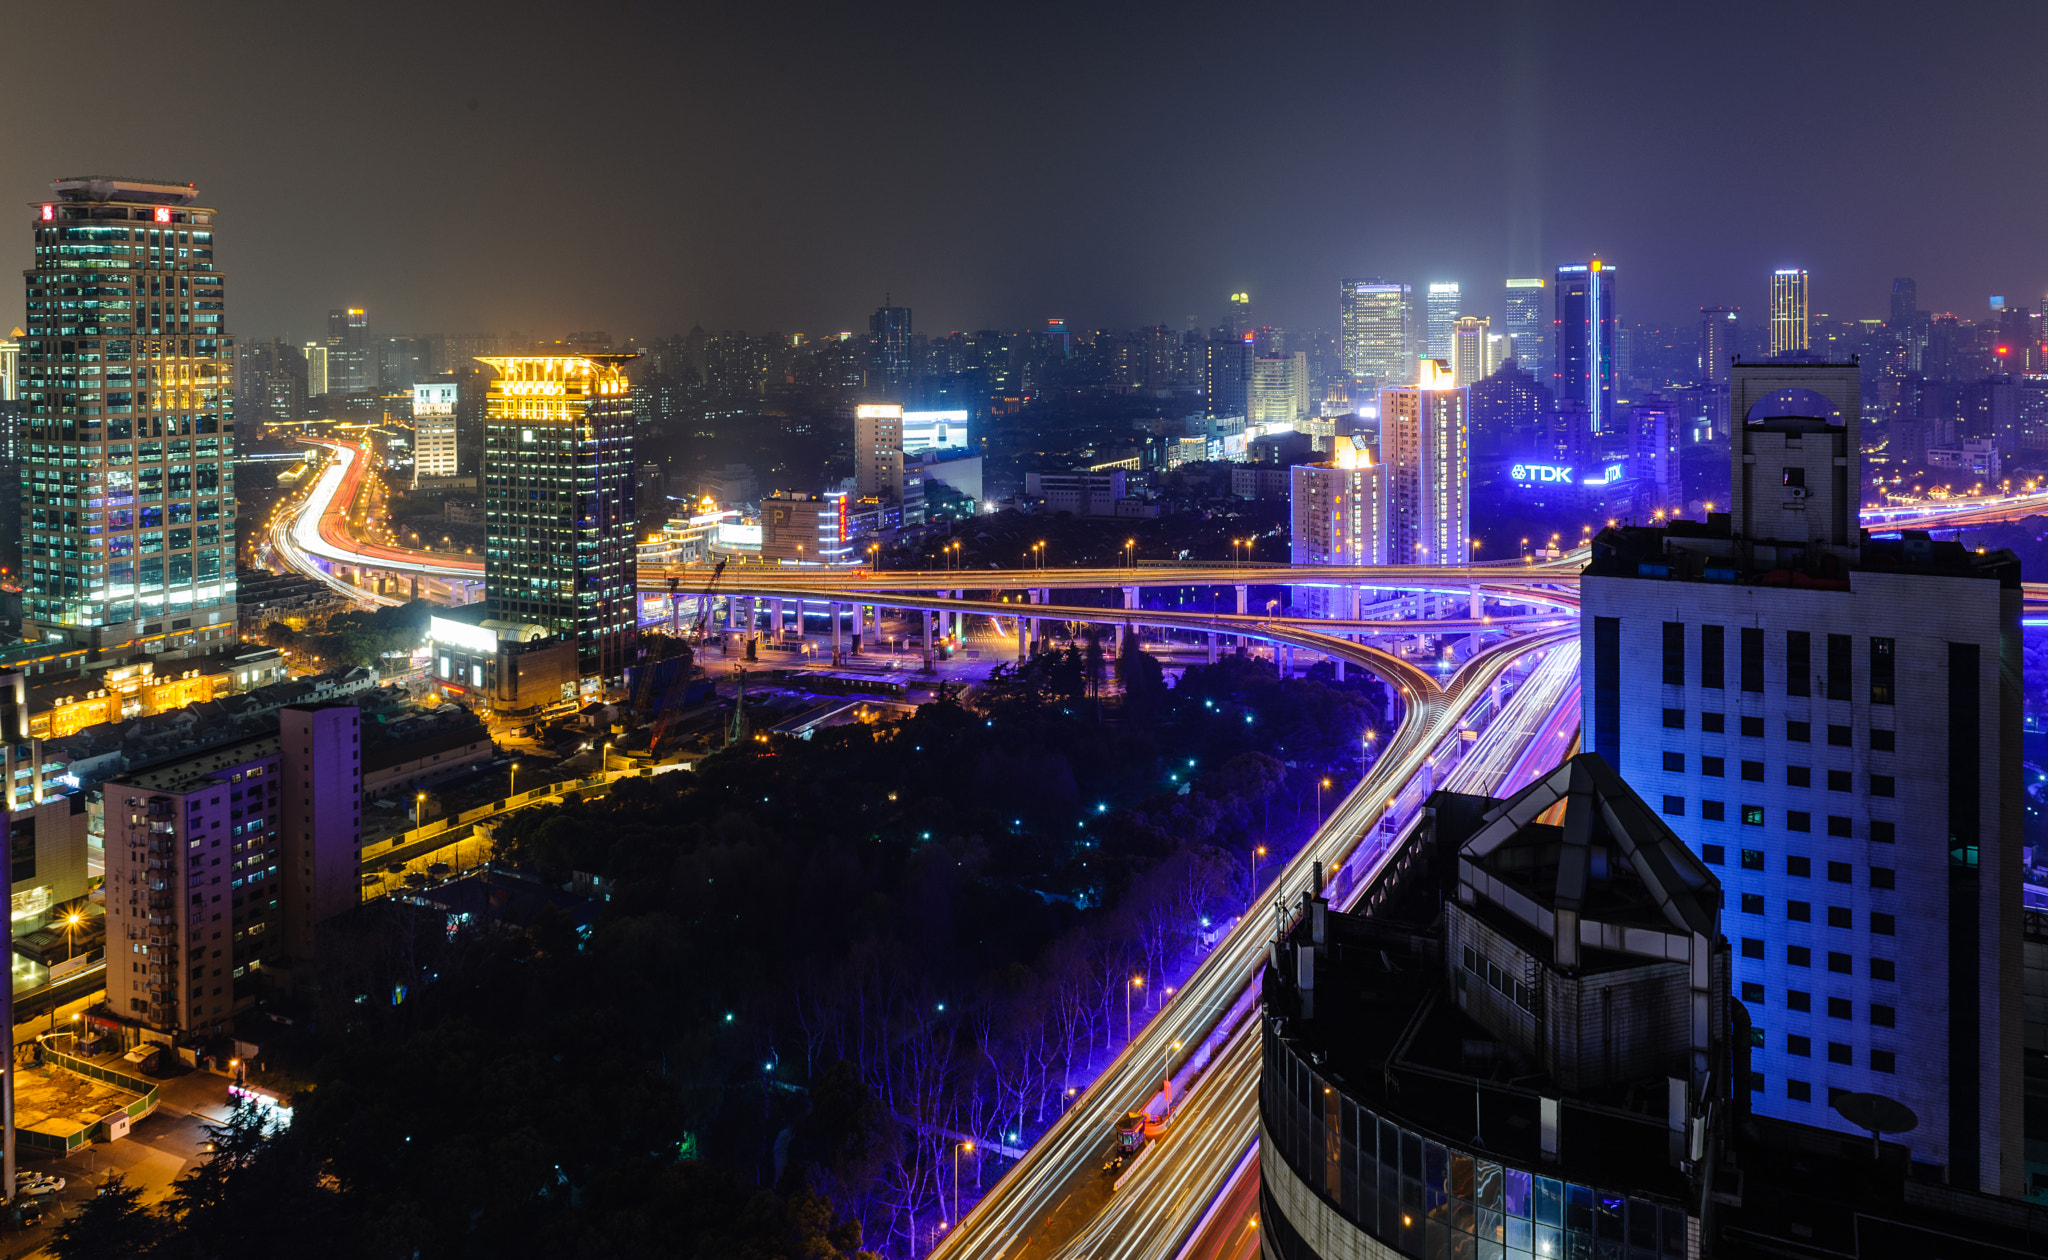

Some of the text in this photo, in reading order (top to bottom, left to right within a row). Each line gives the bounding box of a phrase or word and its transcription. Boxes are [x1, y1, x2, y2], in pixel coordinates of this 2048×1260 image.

[1524, 465, 1573, 483] TDK
[1608, 463, 1622, 483] TDK
[773, 509, 784, 525] P
